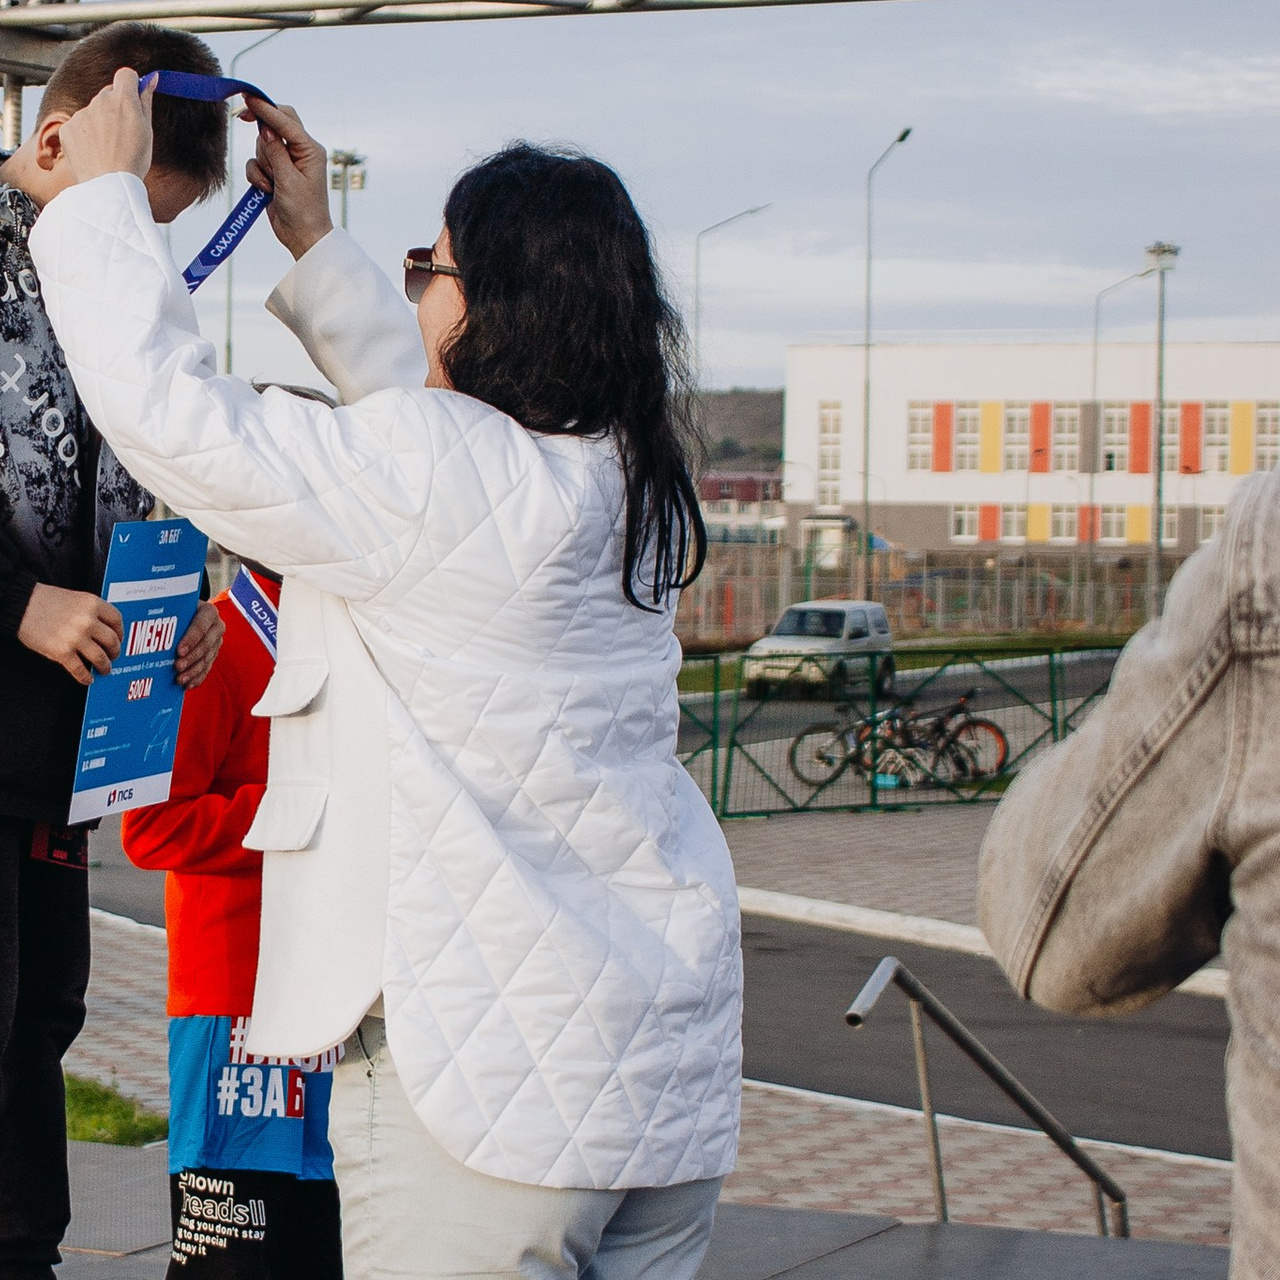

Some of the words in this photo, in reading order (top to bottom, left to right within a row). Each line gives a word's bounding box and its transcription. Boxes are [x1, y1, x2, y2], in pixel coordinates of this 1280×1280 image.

[251, 600, 278, 640] ЛАСТЬ
[131, 616, 178, 655] МЕСТО
[117, 788, 134, 802] ПСБ
[183, 1229, 193, 1239] to
[193, 1232, 227, 1248] special
[196, 1220, 214, 1231] you
[215, 1224, 239, 1237] don't
[241, 1229, 265, 1240] stay
[181, 1242, 197, 1255] say
[198, 1244, 207, 1255] it
